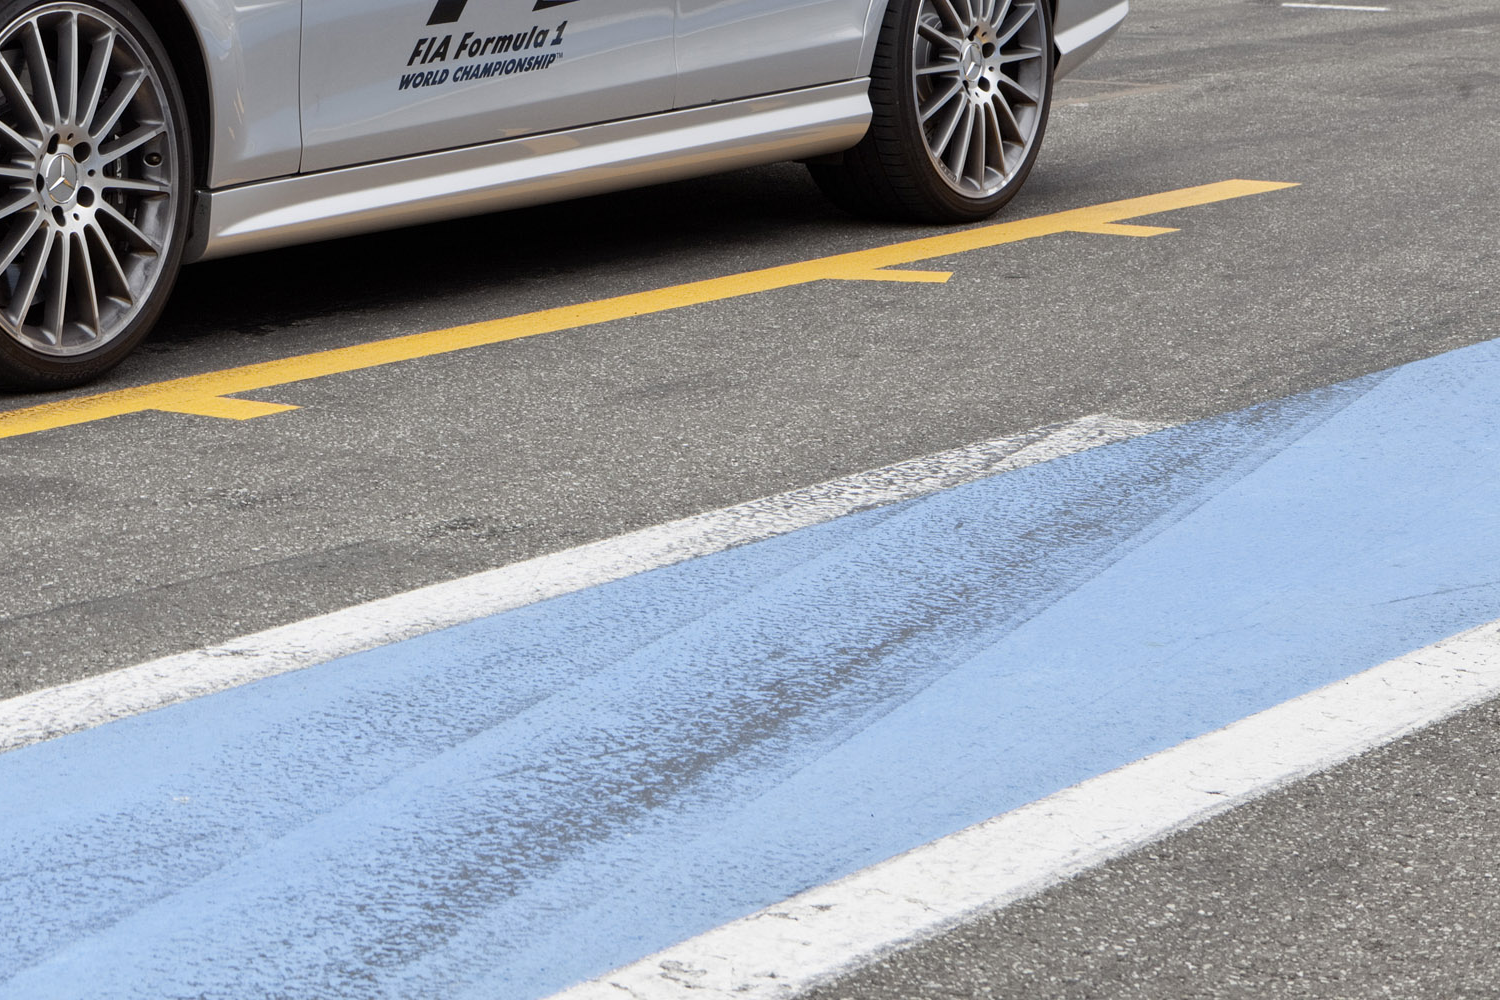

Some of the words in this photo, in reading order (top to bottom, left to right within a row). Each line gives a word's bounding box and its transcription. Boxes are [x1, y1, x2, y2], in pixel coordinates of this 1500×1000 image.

[407, 34, 452, 67] FIA
[454, 26, 546, 60] Formula
[550, 20, 569, 46] 1
[399, 68, 450, 91] WORLD
